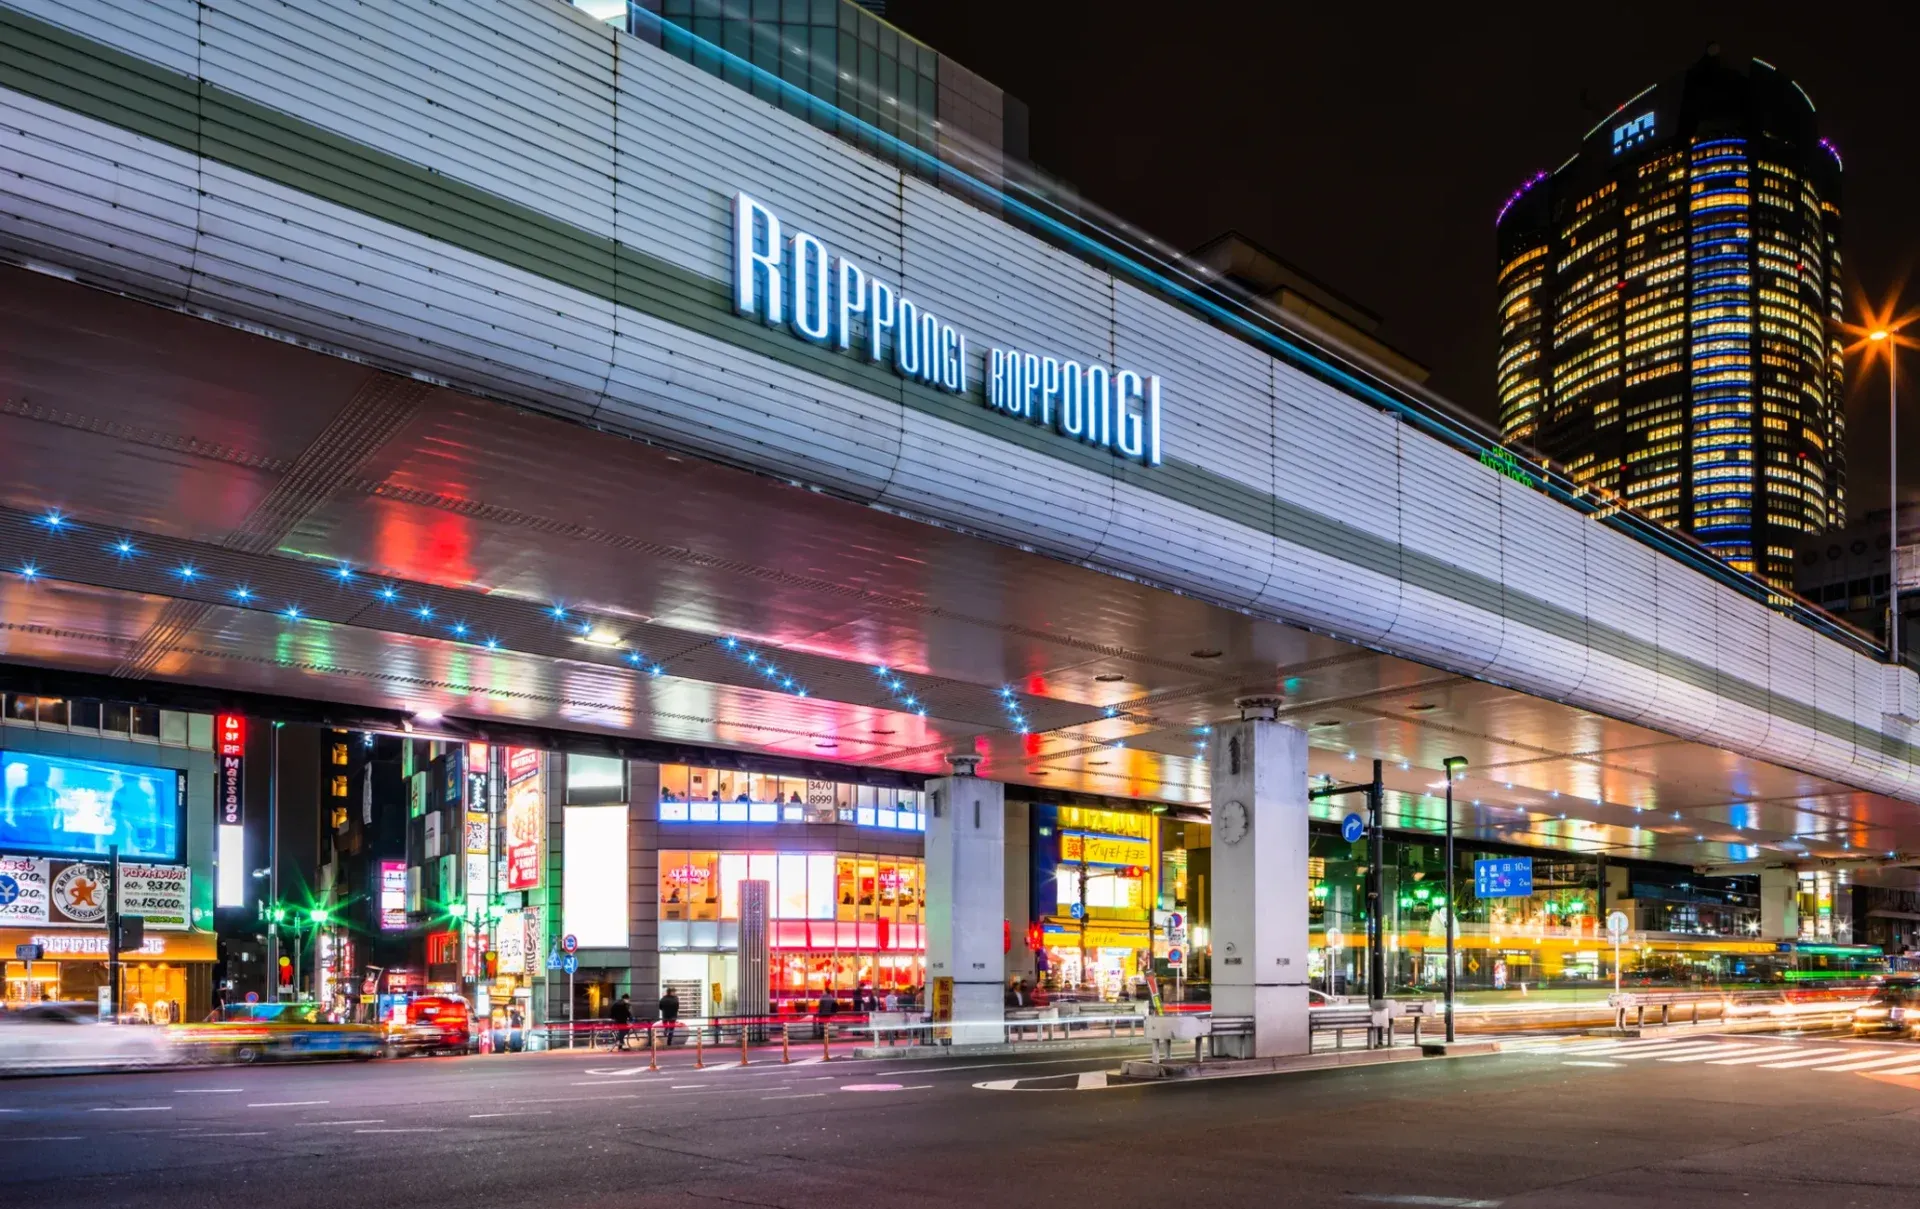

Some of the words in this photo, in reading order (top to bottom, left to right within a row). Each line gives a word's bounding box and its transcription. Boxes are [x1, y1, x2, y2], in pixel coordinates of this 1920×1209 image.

[733, 191, 966, 394] ROPPONGI
[985, 347, 1161, 466] ROPPONGI
[225, 757, 239, 822] Massage
[810, 781, 832, 790] 3470
[810, 795, 832, 804] 8999
